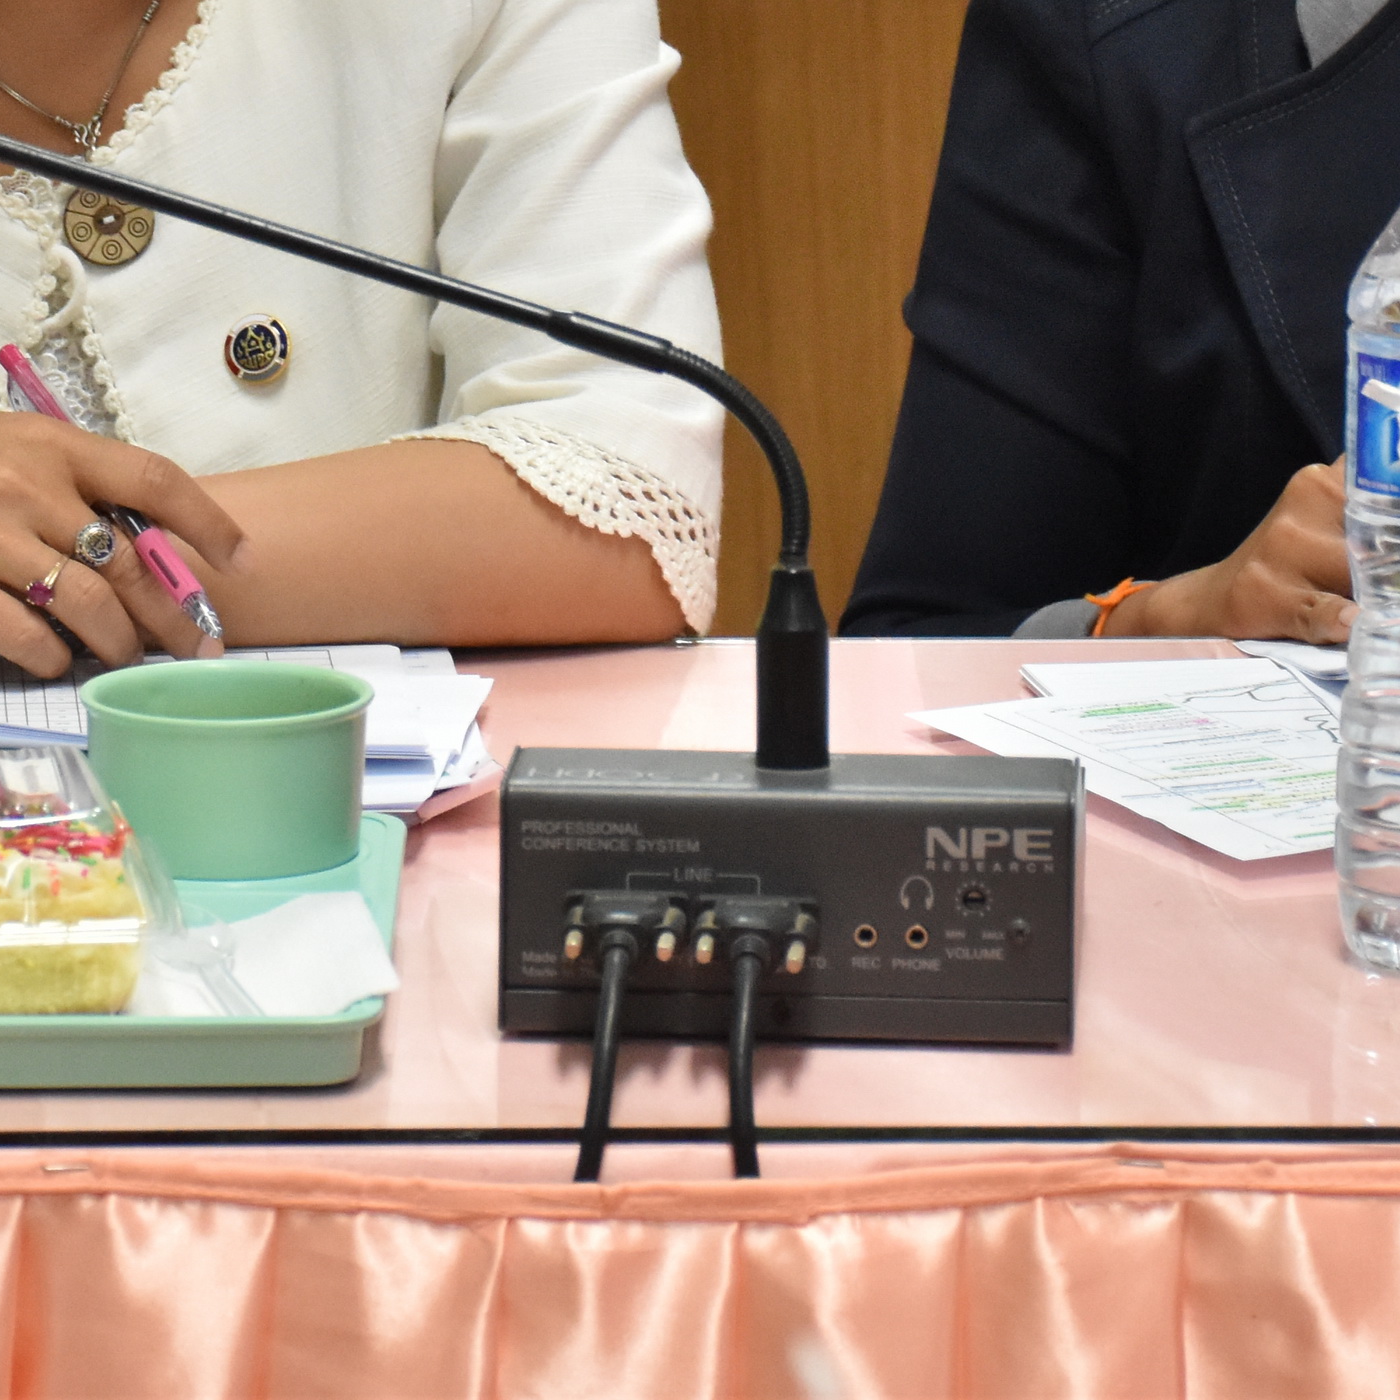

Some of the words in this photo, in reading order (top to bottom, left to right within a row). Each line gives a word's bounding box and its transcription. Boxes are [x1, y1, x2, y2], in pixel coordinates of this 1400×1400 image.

[521, 820, 643, 836] PROFESSIONAL
[521, 837, 631, 852] CONFERENCE
[635, 838, 700, 853] SYSTEM
[925, 826, 1054, 862] NPE
[673, 867, 715, 882] LINE
[925, 861, 1054, 874] RESEARCH
[946, 948, 1004, 962] VOLUME
[851, 956, 882, 970] REC
[892, 957, 942, 972] PHONE
